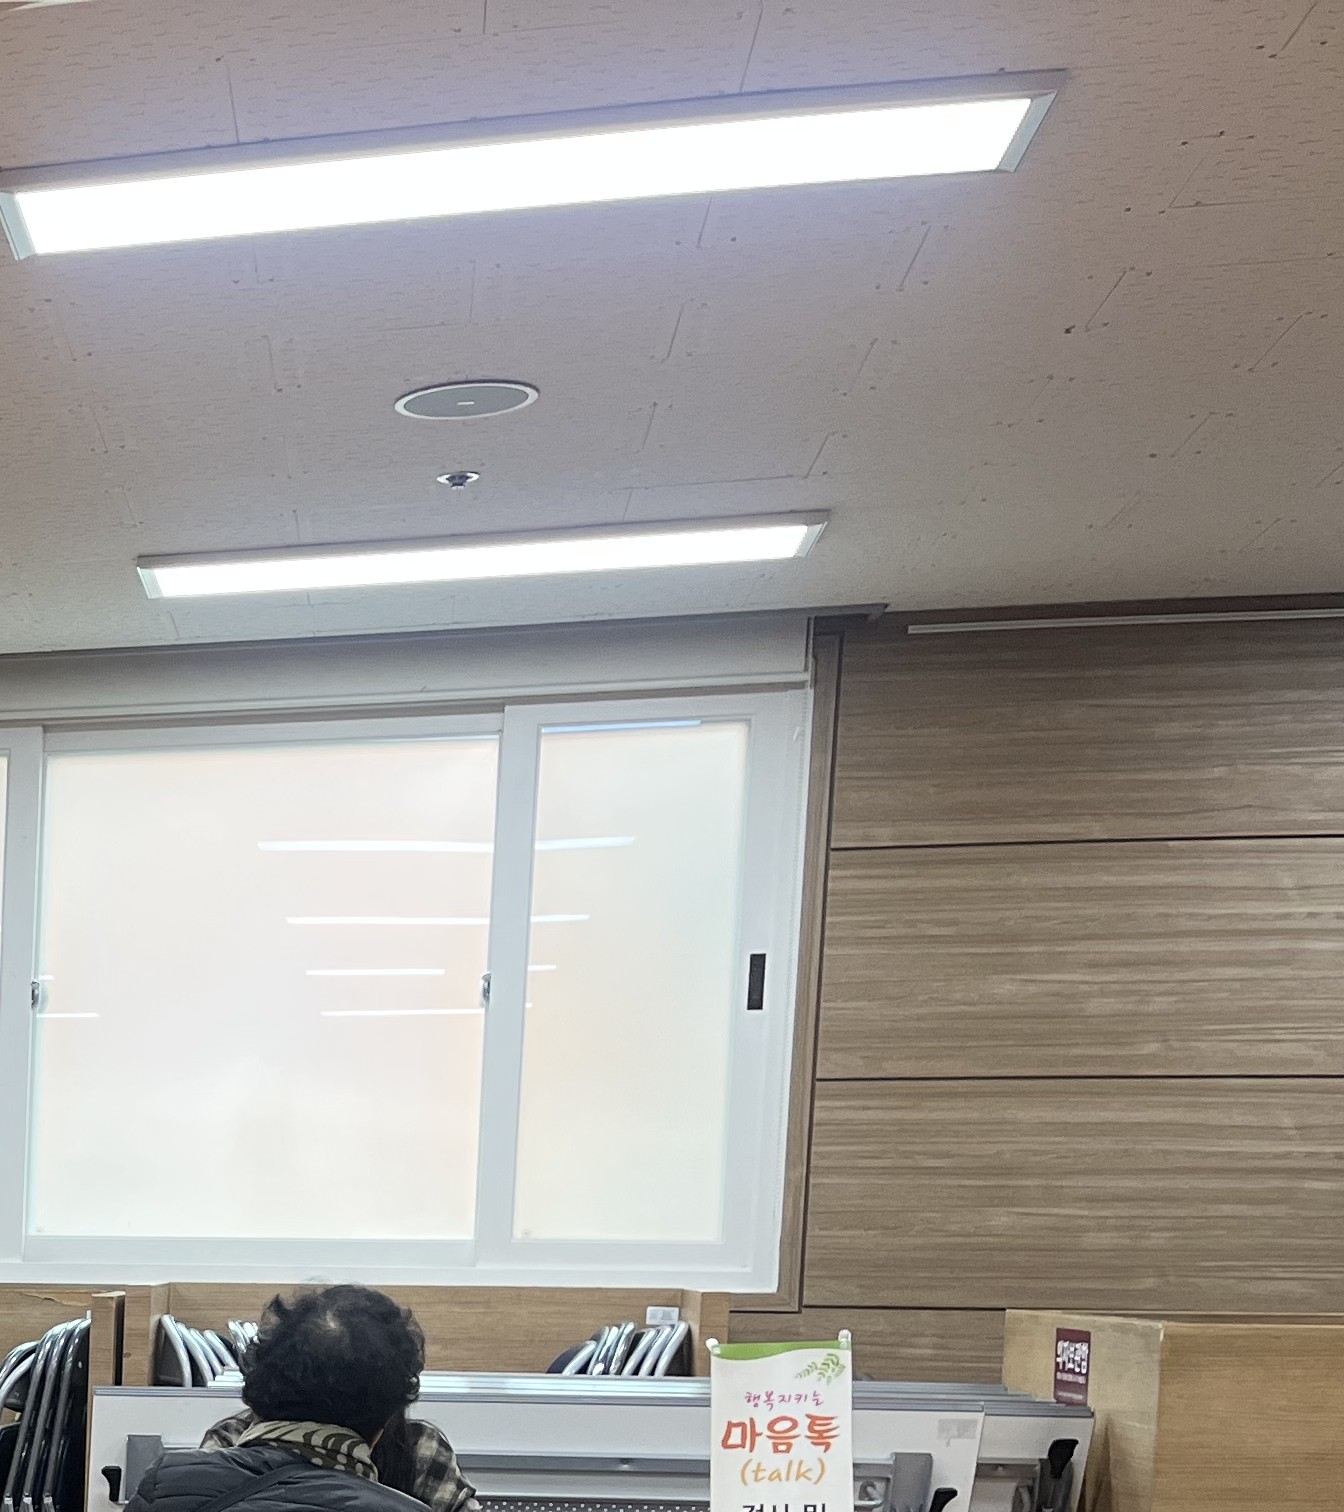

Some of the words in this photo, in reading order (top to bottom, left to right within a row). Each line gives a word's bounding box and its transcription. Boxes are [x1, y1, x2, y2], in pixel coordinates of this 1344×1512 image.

[744, 1390, 824, 1412] 행복지키는
[721, 1413, 840, 1454] 마음톡
[739, 1458, 827, 1486] (talk)
